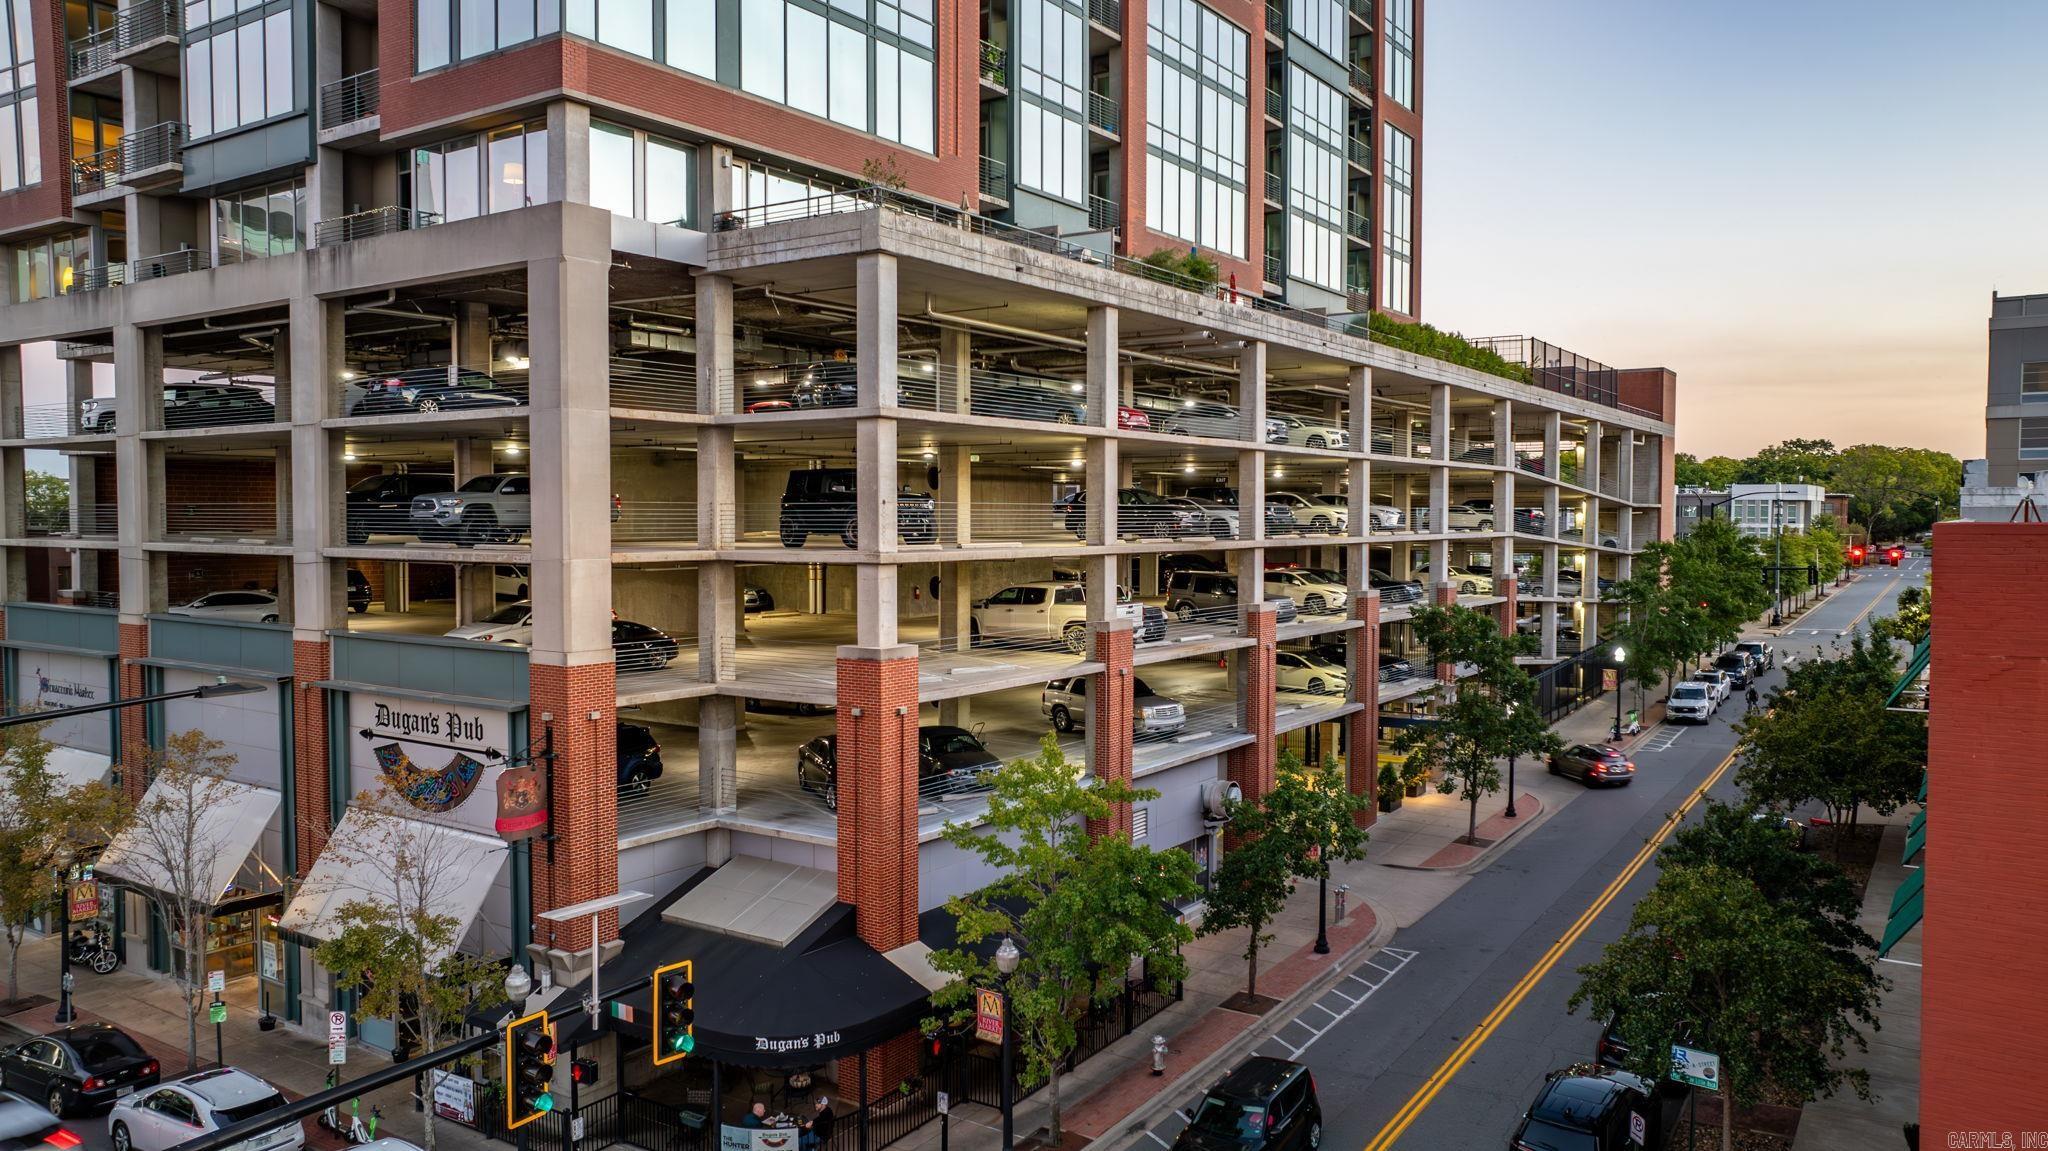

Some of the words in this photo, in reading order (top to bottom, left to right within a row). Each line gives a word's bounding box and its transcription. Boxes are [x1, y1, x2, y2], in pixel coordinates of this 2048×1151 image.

[374, 701, 440, 735] Dugan's
[445, 711, 484, 742] Pub
[755, 1036, 809, 1053] Dugan's
[813, 1031, 841, 1049] Pub
[723, 1141, 750, 1150] HUNTER
